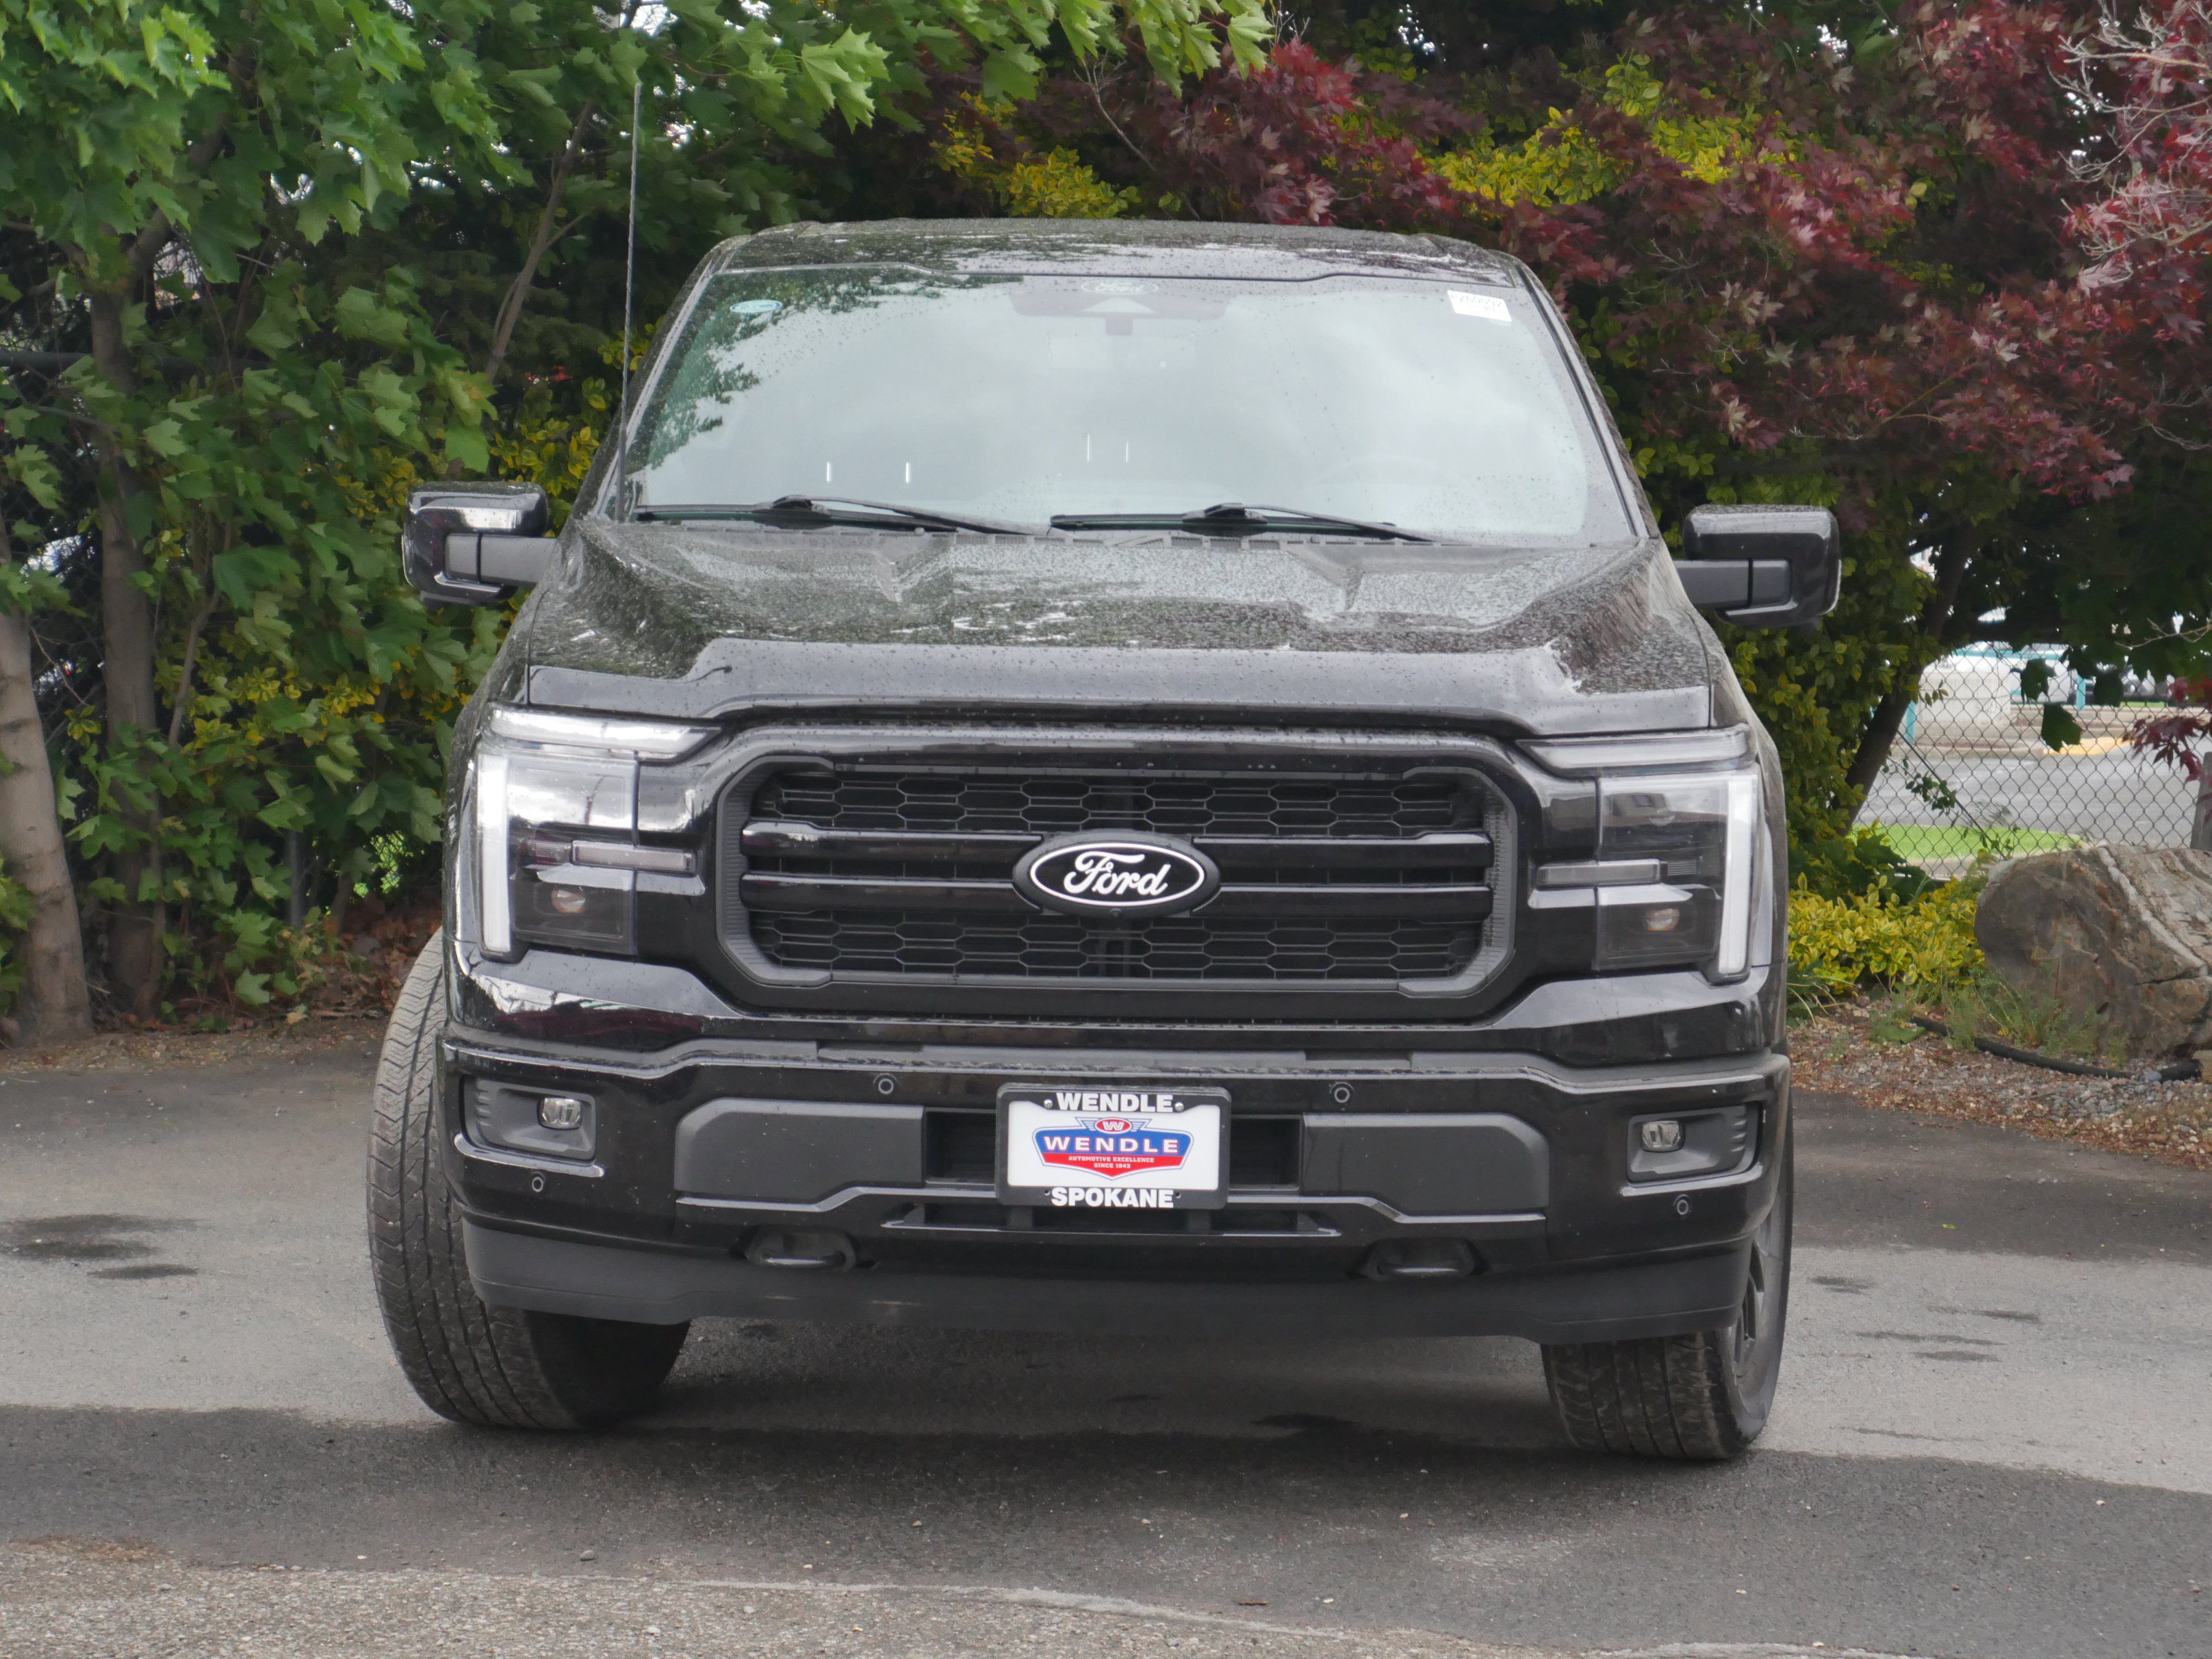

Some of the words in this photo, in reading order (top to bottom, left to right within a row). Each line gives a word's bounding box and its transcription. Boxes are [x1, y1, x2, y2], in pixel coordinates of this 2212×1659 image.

[1064, 851, 1171, 895] Ford
[1056, 1092, 1173, 1113] WENDLE
[1102, 1120, 1124, 1131] W
[1044, 1136, 1179, 1154] WENDLE
[1051, 1187, 1174, 1208] SPOKANE
